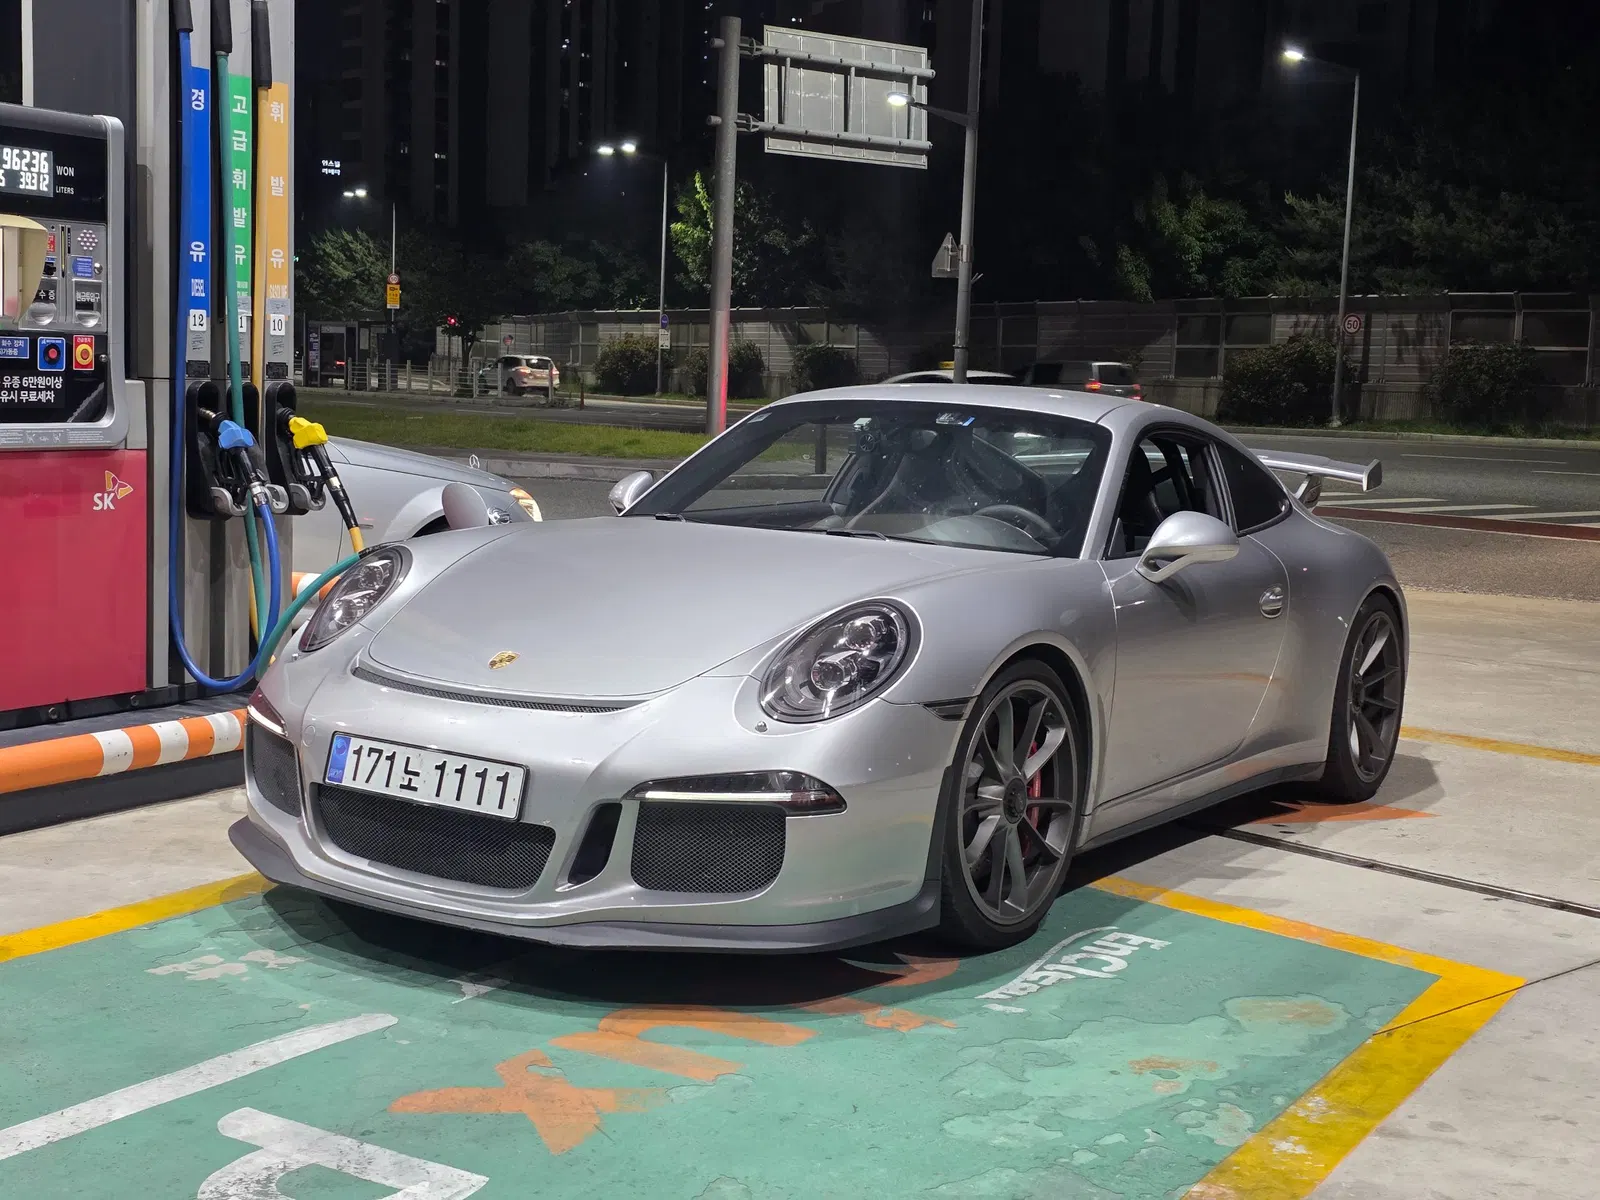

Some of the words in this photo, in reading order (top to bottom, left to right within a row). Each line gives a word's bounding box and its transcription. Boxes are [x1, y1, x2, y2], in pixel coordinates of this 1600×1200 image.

[2, 147, 49, 174] 96236
[56, 165, 75, 177] WON
[190, 88, 206, 263] 경유
[55, 186, 75, 195] LITERS
[192, 313, 205, 328] 12
[272, 318, 284, 332] 10
[1347, 319, 1358, 330] 50
[3, 375, 21, 389] 유종
[22, 375, 63, 389] 6만원이상
[20, 390, 55, 403] 무료세차
[93, 492, 116, 511] SK
[352, 744, 420, 792] 171노
[434, 760, 510, 810] 1111
